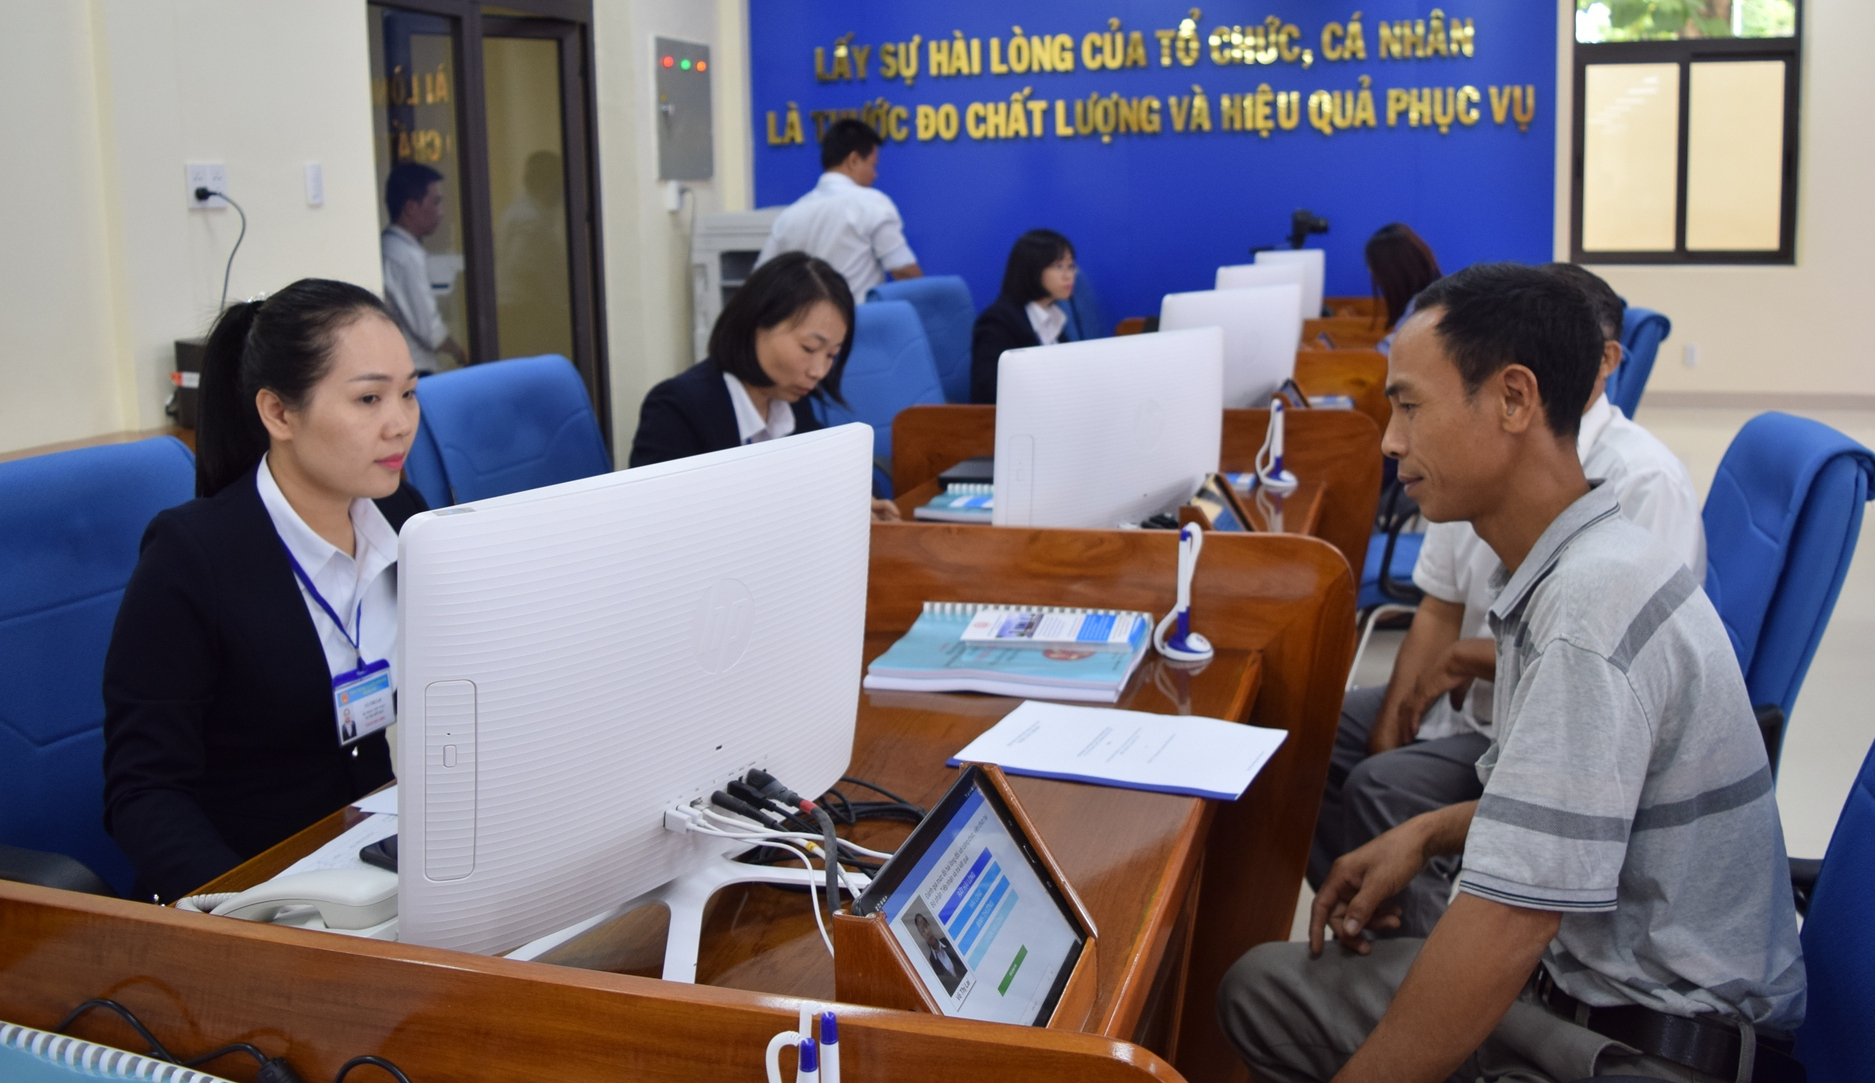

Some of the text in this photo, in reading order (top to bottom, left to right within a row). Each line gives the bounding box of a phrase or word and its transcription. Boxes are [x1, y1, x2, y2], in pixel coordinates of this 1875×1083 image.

[815, 32, 871, 81] LẤY
[880, 34, 922, 86] SỰ
[929, 30, 981, 76] HÀI
[990, 26, 1074, 74] LÒNG
[1082, 18, 1147, 69] CỦA
[1155, 8, 1202, 67] TỔ
[1321, 11, 1367, 61] CÁ
[1379, 9, 1475, 60] NHÂN
[766, 75, 1535, 145] LÀ TỚC ĐO CHẤT LƯỢNG VÀ HIỆU QUẢ PHỤC VỤ
